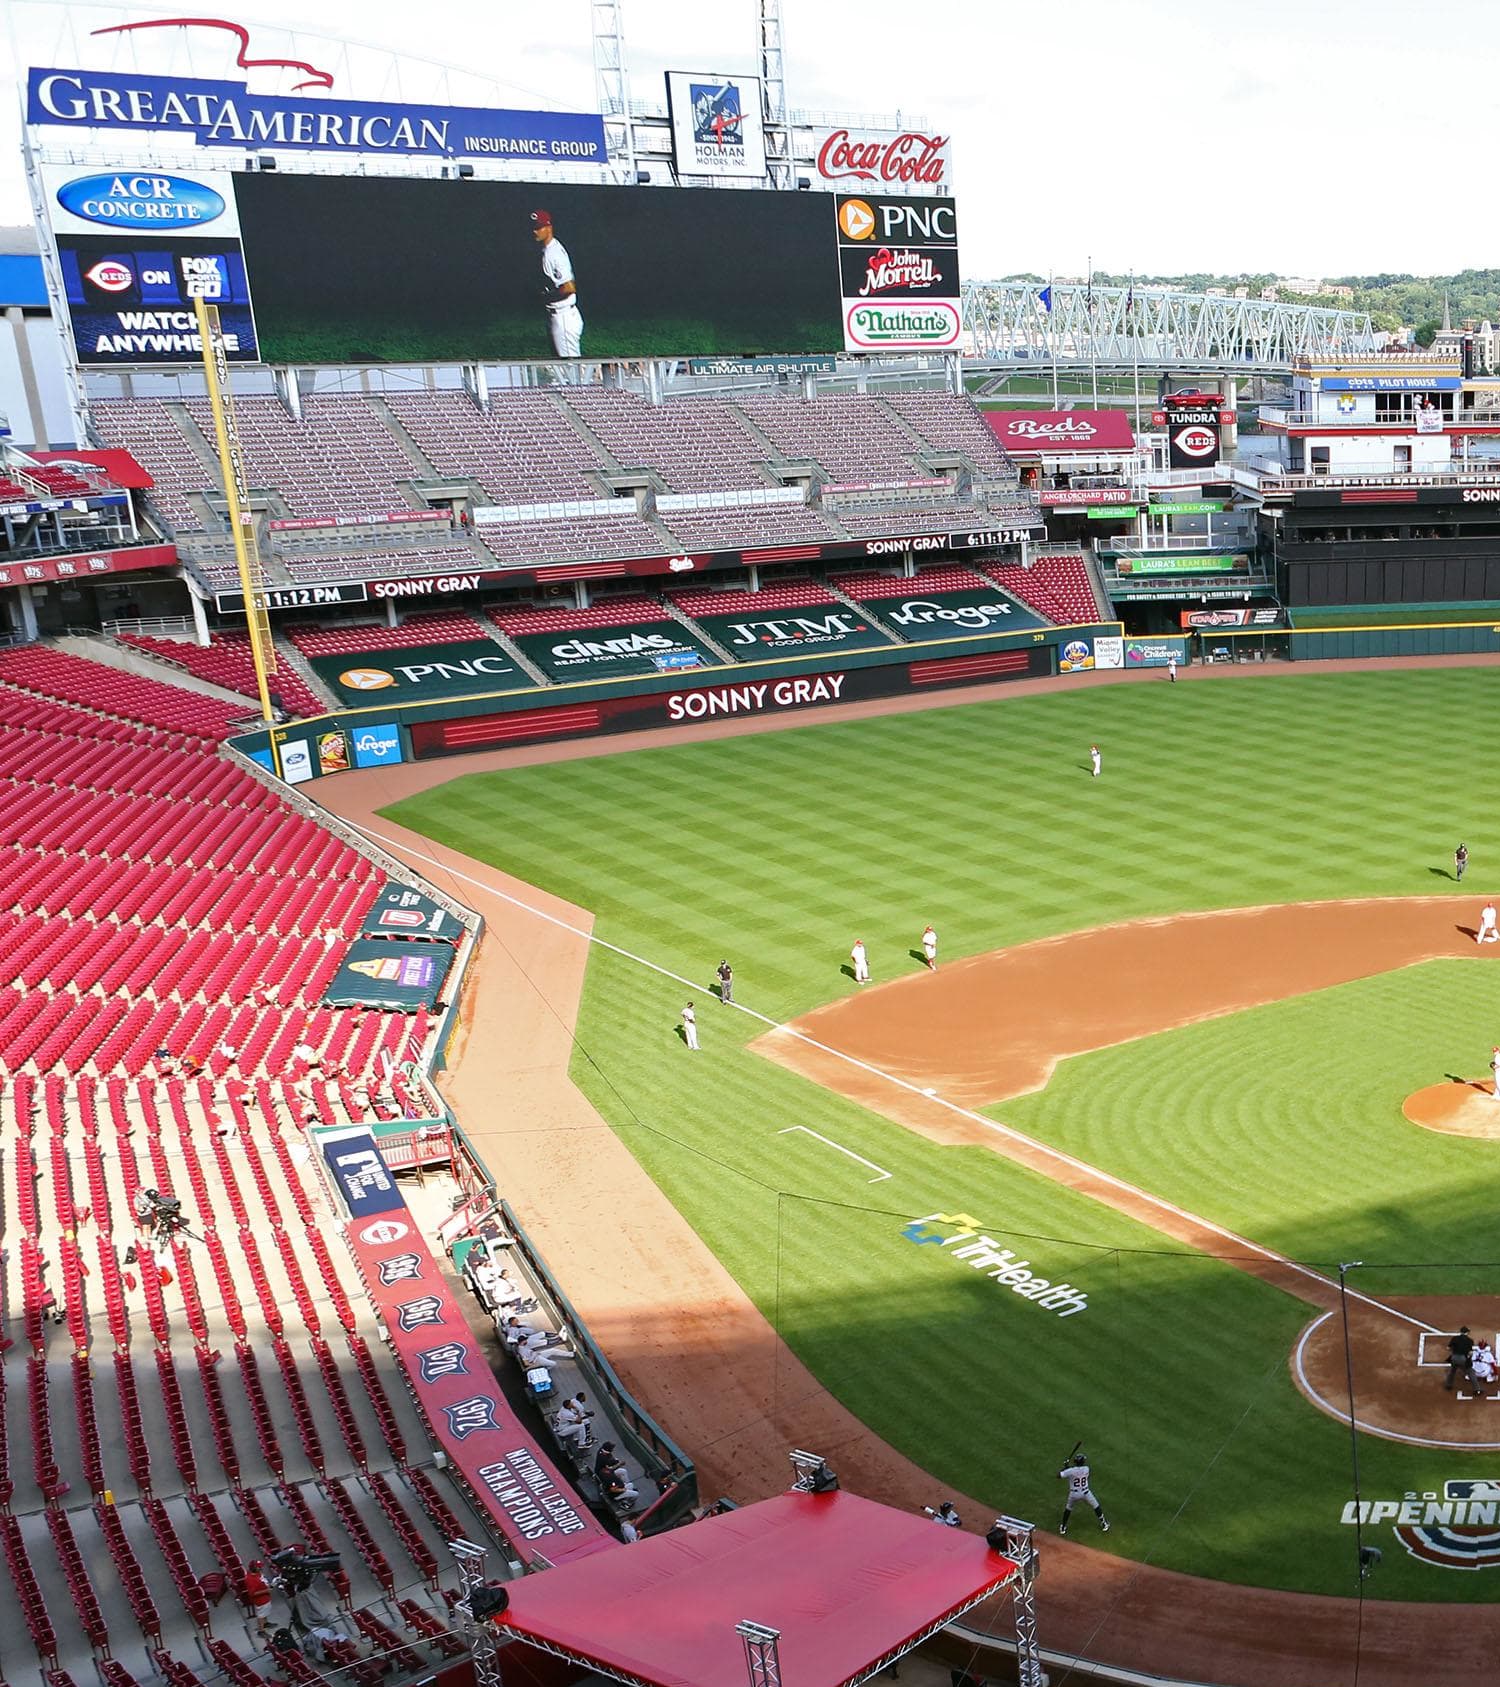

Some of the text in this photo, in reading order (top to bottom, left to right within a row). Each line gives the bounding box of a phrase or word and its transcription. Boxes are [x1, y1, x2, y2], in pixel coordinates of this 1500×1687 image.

[464, 137, 547, 155] INSURANCE
[550, 140, 597, 157] GROUP
[695, 146, 745, 157] HOLMAN
[818, 130, 949, 184] Coca-Cola
[109, 177, 175, 199] ACR
[83, 200, 201, 220] CONCRETE
[878, 205, 955, 238] PNC
[181, 257, 219, 274] FOX
[888, 249, 920, 268] John
[101, 272, 132, 282] REDS
[142, 271, 171, 285] ON
[859, 259, 942, 296] Morrell
[186, 280, 221, 297] GO
[117, 312, 201, 330] WATCH
[855, 309, 950, 333] Nathan's
[694, 362, 832, 375] ULTIMATE AIR SHUTTLE
[1348, 378, 1437, 388] cbts PILOT HOUSE
[1169, 412, 1217, 424] TUNDRA
[1007, 417, 1097, 440] Reds
[1186, 436, 1216, 447] REDS
[1068, 492, 1101, 500] ORCHARD
[1103, 491, 1126, 501] PATIO
[866, 536, 946, 555] SONNY GRAY
[967, 529, 1031, 546] 6:11:12 PM
[669, 555, 695, 572] Reds
[1141, 559, 1201, 568] LAURA'S LEAN
[374, 575, 481, 598] SONNY GRAY
[251, 587, 341, 608] :11:12 PM
[889, 601, 1012, 629] Kroger
[768, 634, 845, 648] FOOD GROUP
[553, 645, 693, 667] READY FOR THE WORKDAY
[1144, 650, 1183, 658] Children's
[393, 656, 513, 683] PNC
[668, 675, 845, 720] SONNY GRAY
[356, 734, 398, 756] Kroger
[345, 1174, 367, 1200] CHANGE
[360, 1174, 375, 1187] FOR
[373, 1166, 392, 1191] UNITED
[384, 1254, 415, 1281] 1939
[951, 1235, 1089, 1318] TriHealth
[405, 1300, 439, 1327] 1961
[427, 1344, 460, 1376] 1970
[451, 1399, 489, 1432] 1972
[505, 1447, 585, 1535] NATIONAL LEAGUE
[1073, 1476, 1088, 1488] 28
[478, 1462, 554, 1541] CHAMPIONS
[1404, 1491, 1438, 1500] 20
